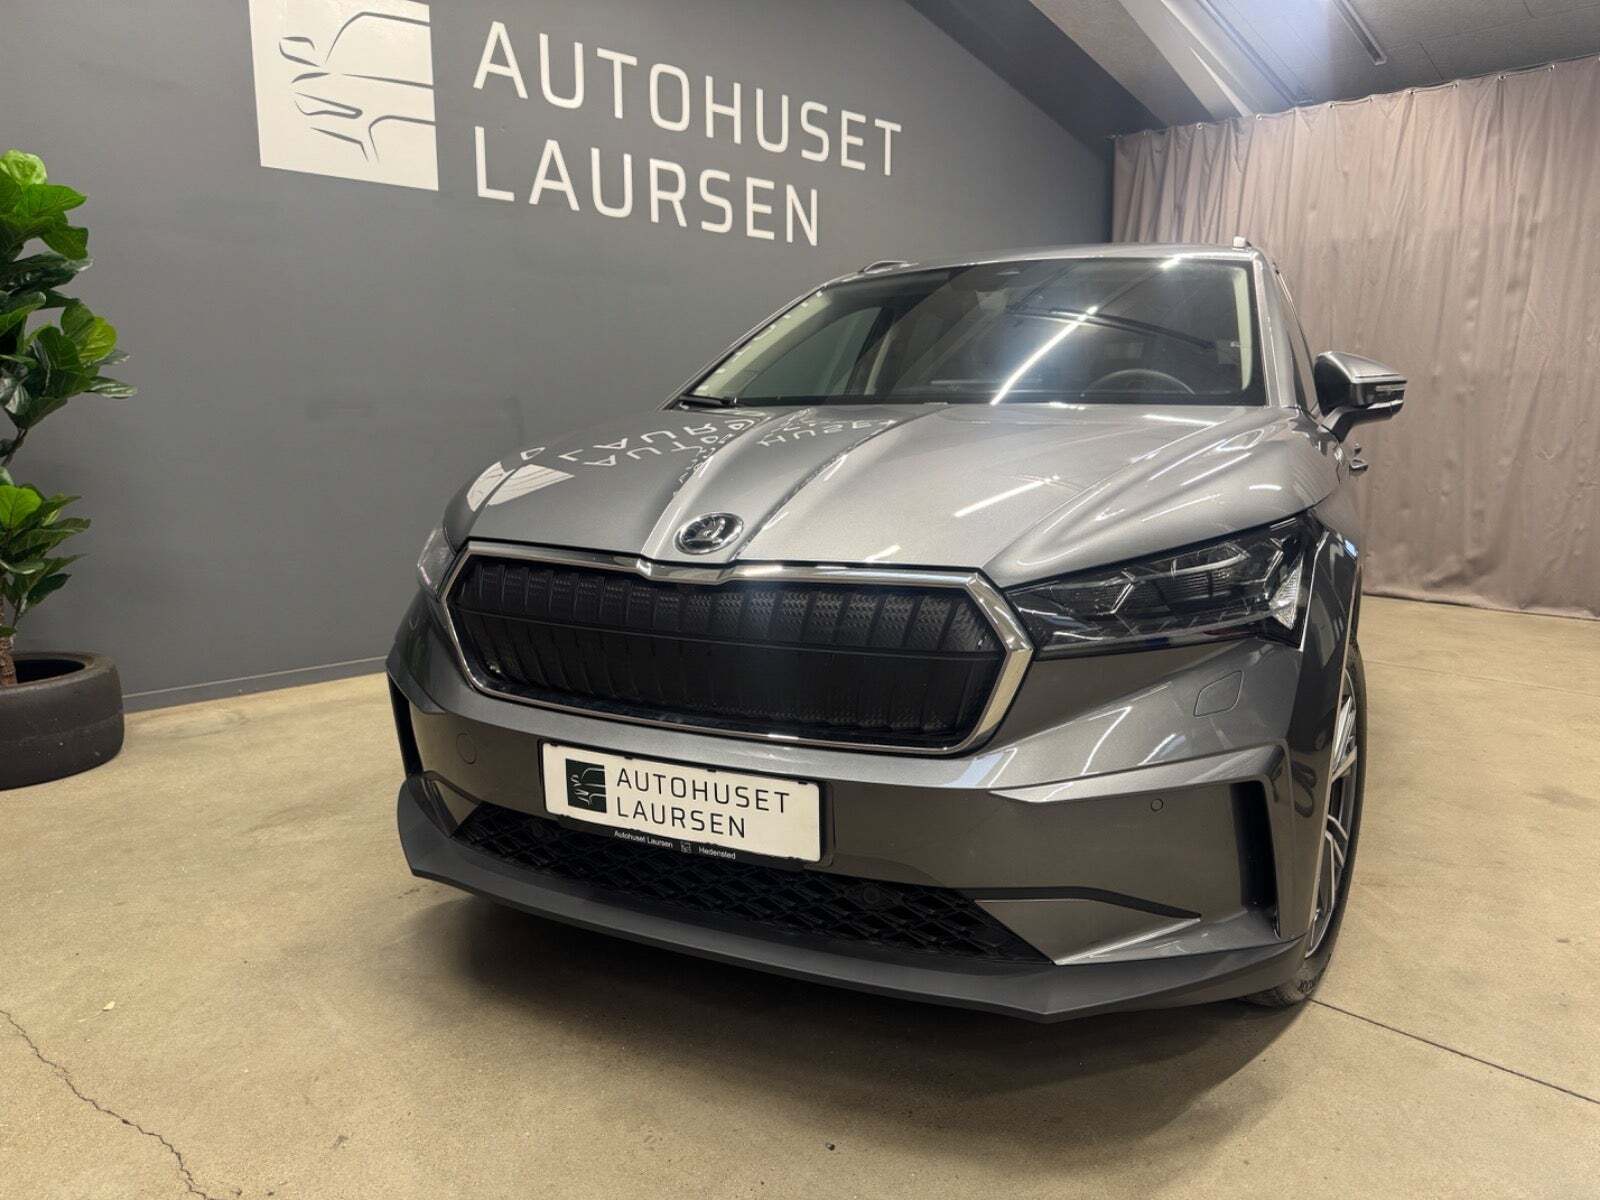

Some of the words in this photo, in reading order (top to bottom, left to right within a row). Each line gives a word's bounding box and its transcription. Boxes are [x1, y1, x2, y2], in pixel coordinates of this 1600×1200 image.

[473, 20, 902, 176] AUTOHUSET
[474, 125, 818, 247] LAURSEN
[616, 767, 790, 813] AUTOHUSET
[616, 796, 745, 838] LAURSEN
[614, 829, 646, 843] Autohuset
[647, 836, 673, 849] Laursen
[698, 845, 736, 860] Hedensted
